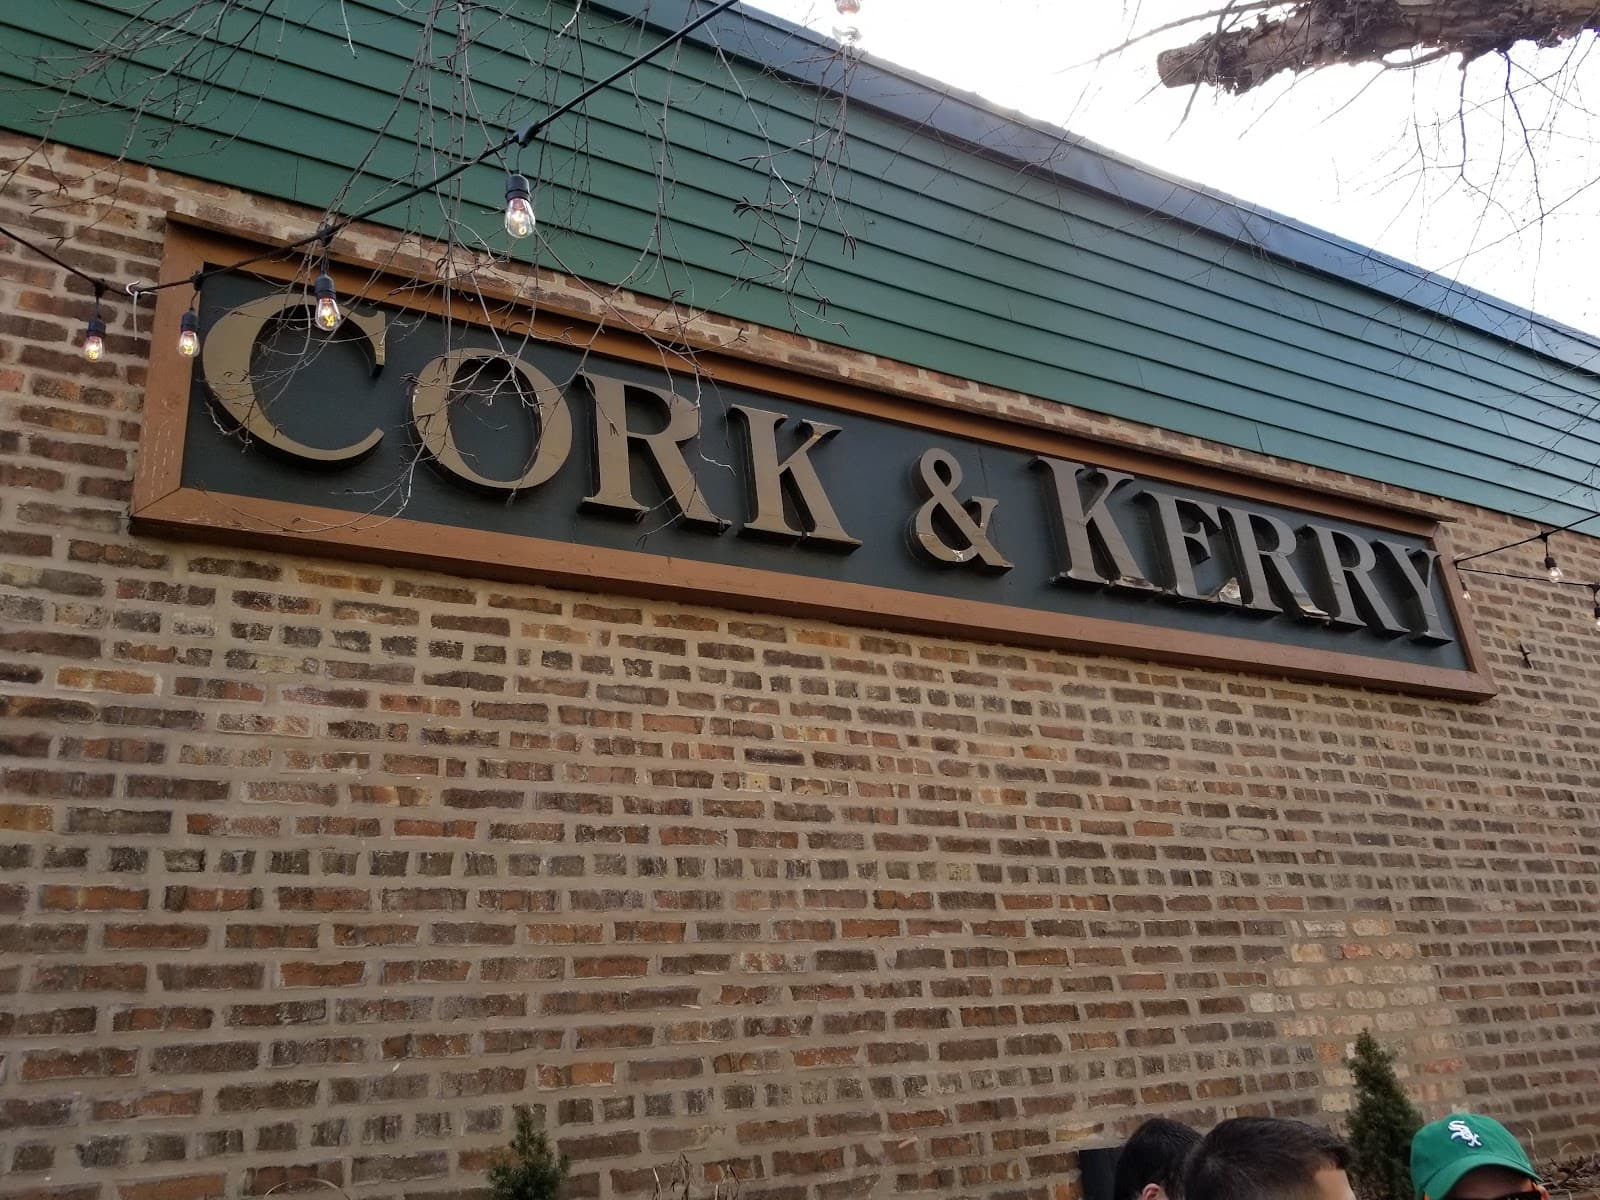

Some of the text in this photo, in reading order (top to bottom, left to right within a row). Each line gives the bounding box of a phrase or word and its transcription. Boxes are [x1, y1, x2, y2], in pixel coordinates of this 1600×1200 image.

[202, 293, 1455, 645] CORK & KERRY
